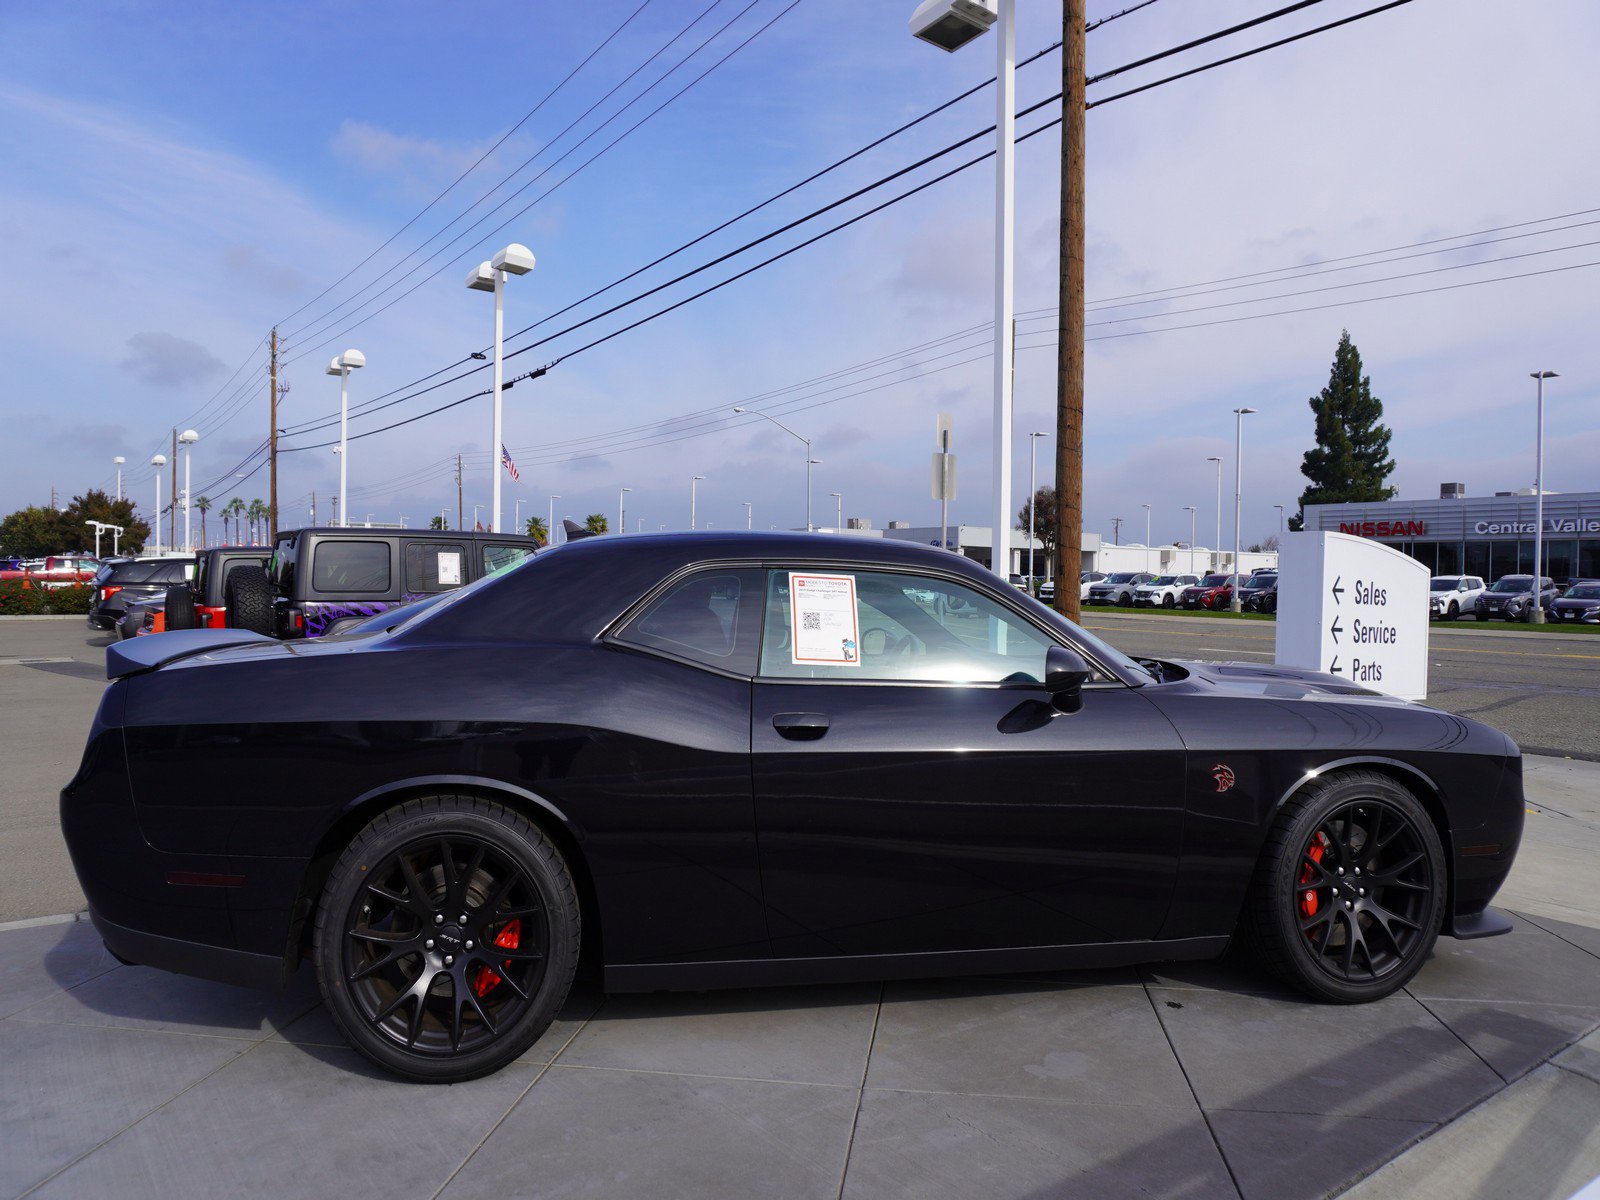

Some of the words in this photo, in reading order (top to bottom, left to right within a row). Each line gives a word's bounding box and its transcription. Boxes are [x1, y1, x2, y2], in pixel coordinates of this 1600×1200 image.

[1340, 520, 1424, 537] NISSAN
[1474, 521, 1538, 534] Centra
[1550, 519, 1600, 533] Valle
[1355, 579, 1387, 606] Sales
[1353, 618, 1397, 644] Service
[1352, 658, 1383, 682] Parts
[439, 933, 461, 944] SRT
